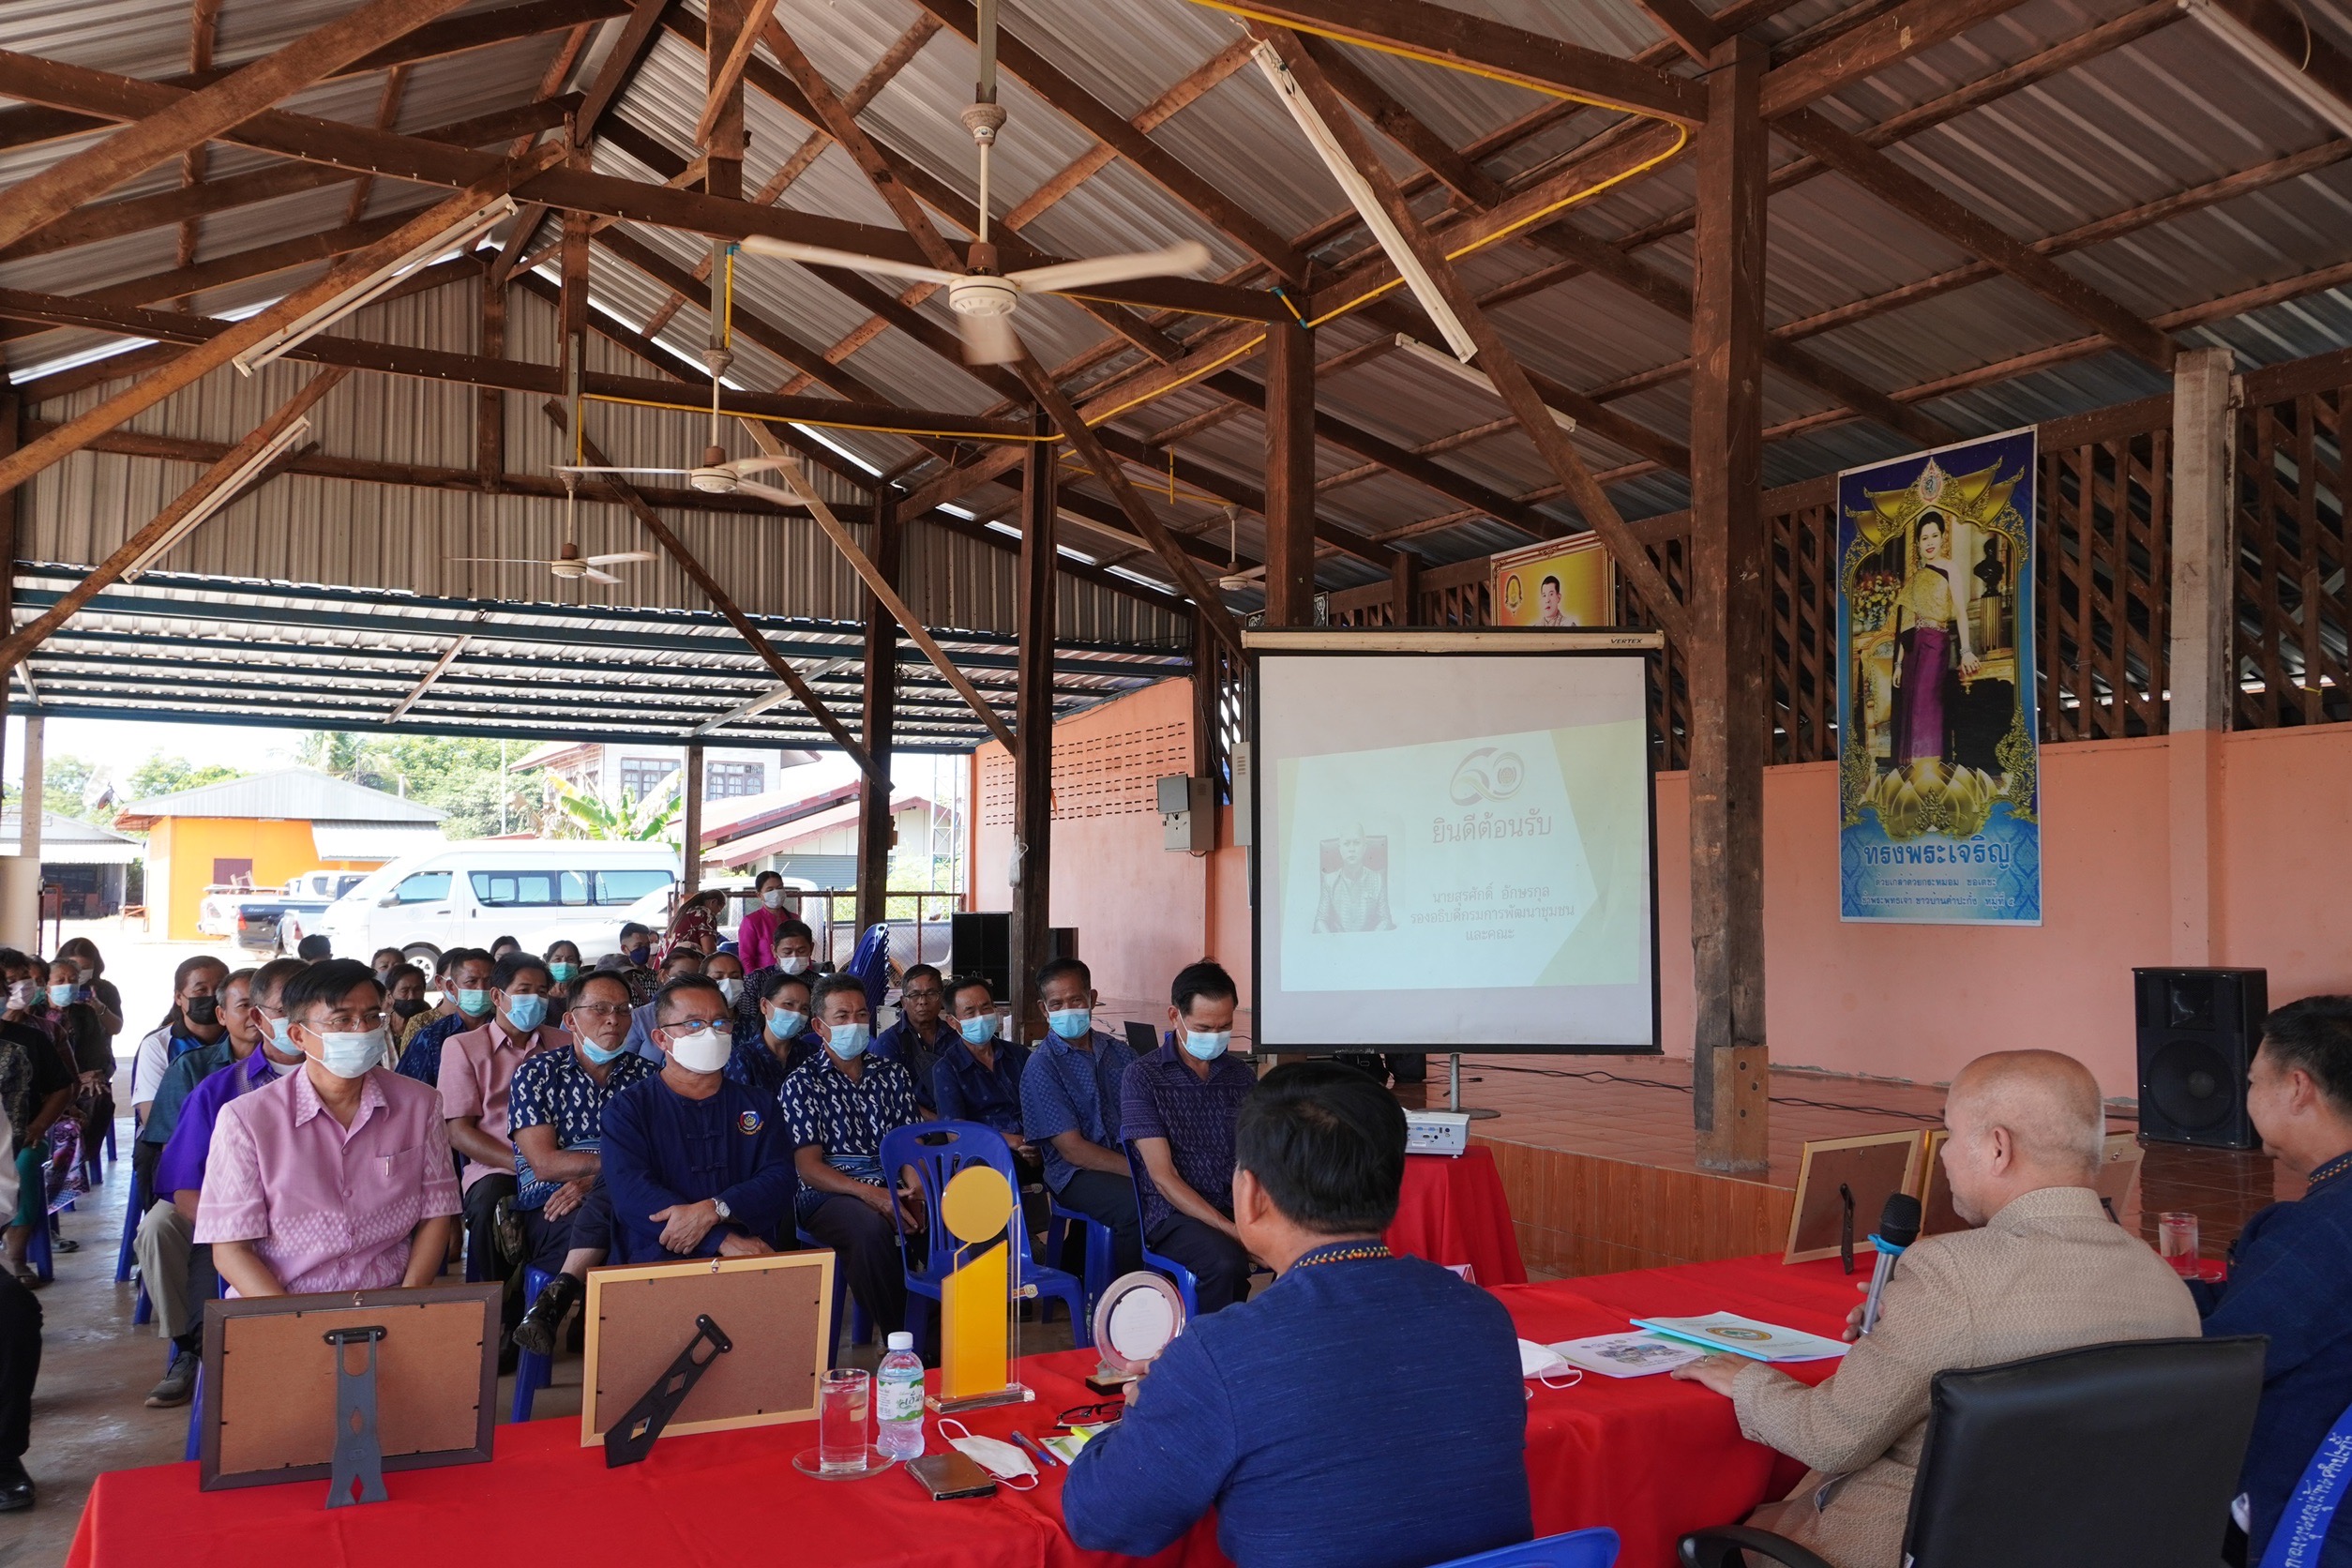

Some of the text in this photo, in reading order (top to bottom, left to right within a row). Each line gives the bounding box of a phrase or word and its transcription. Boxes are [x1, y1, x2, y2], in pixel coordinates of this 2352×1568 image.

[1432, 807, 1553, 844] ยินดีต้อนรับ
[1863, 834, 2011, 870] ทรงพระเจริญ
[1875, 872, 1998, 887] ด้วยเกล้าด้วยกระหม่อม ขอเดชะ
[1432, 882, 1550, 906] นายสุรศักดิ์ อักษรกุล
[1861, 890, 1913, 909] ข้าพระพุทธเจ้า
[1984, 890, 2006, 911] หมู่ที่
[1410, 904, 1576, 925] รองอธิบดีกรมการพัฒนาชุมชน
[1465, 927, 1515, 942] และคณะ
